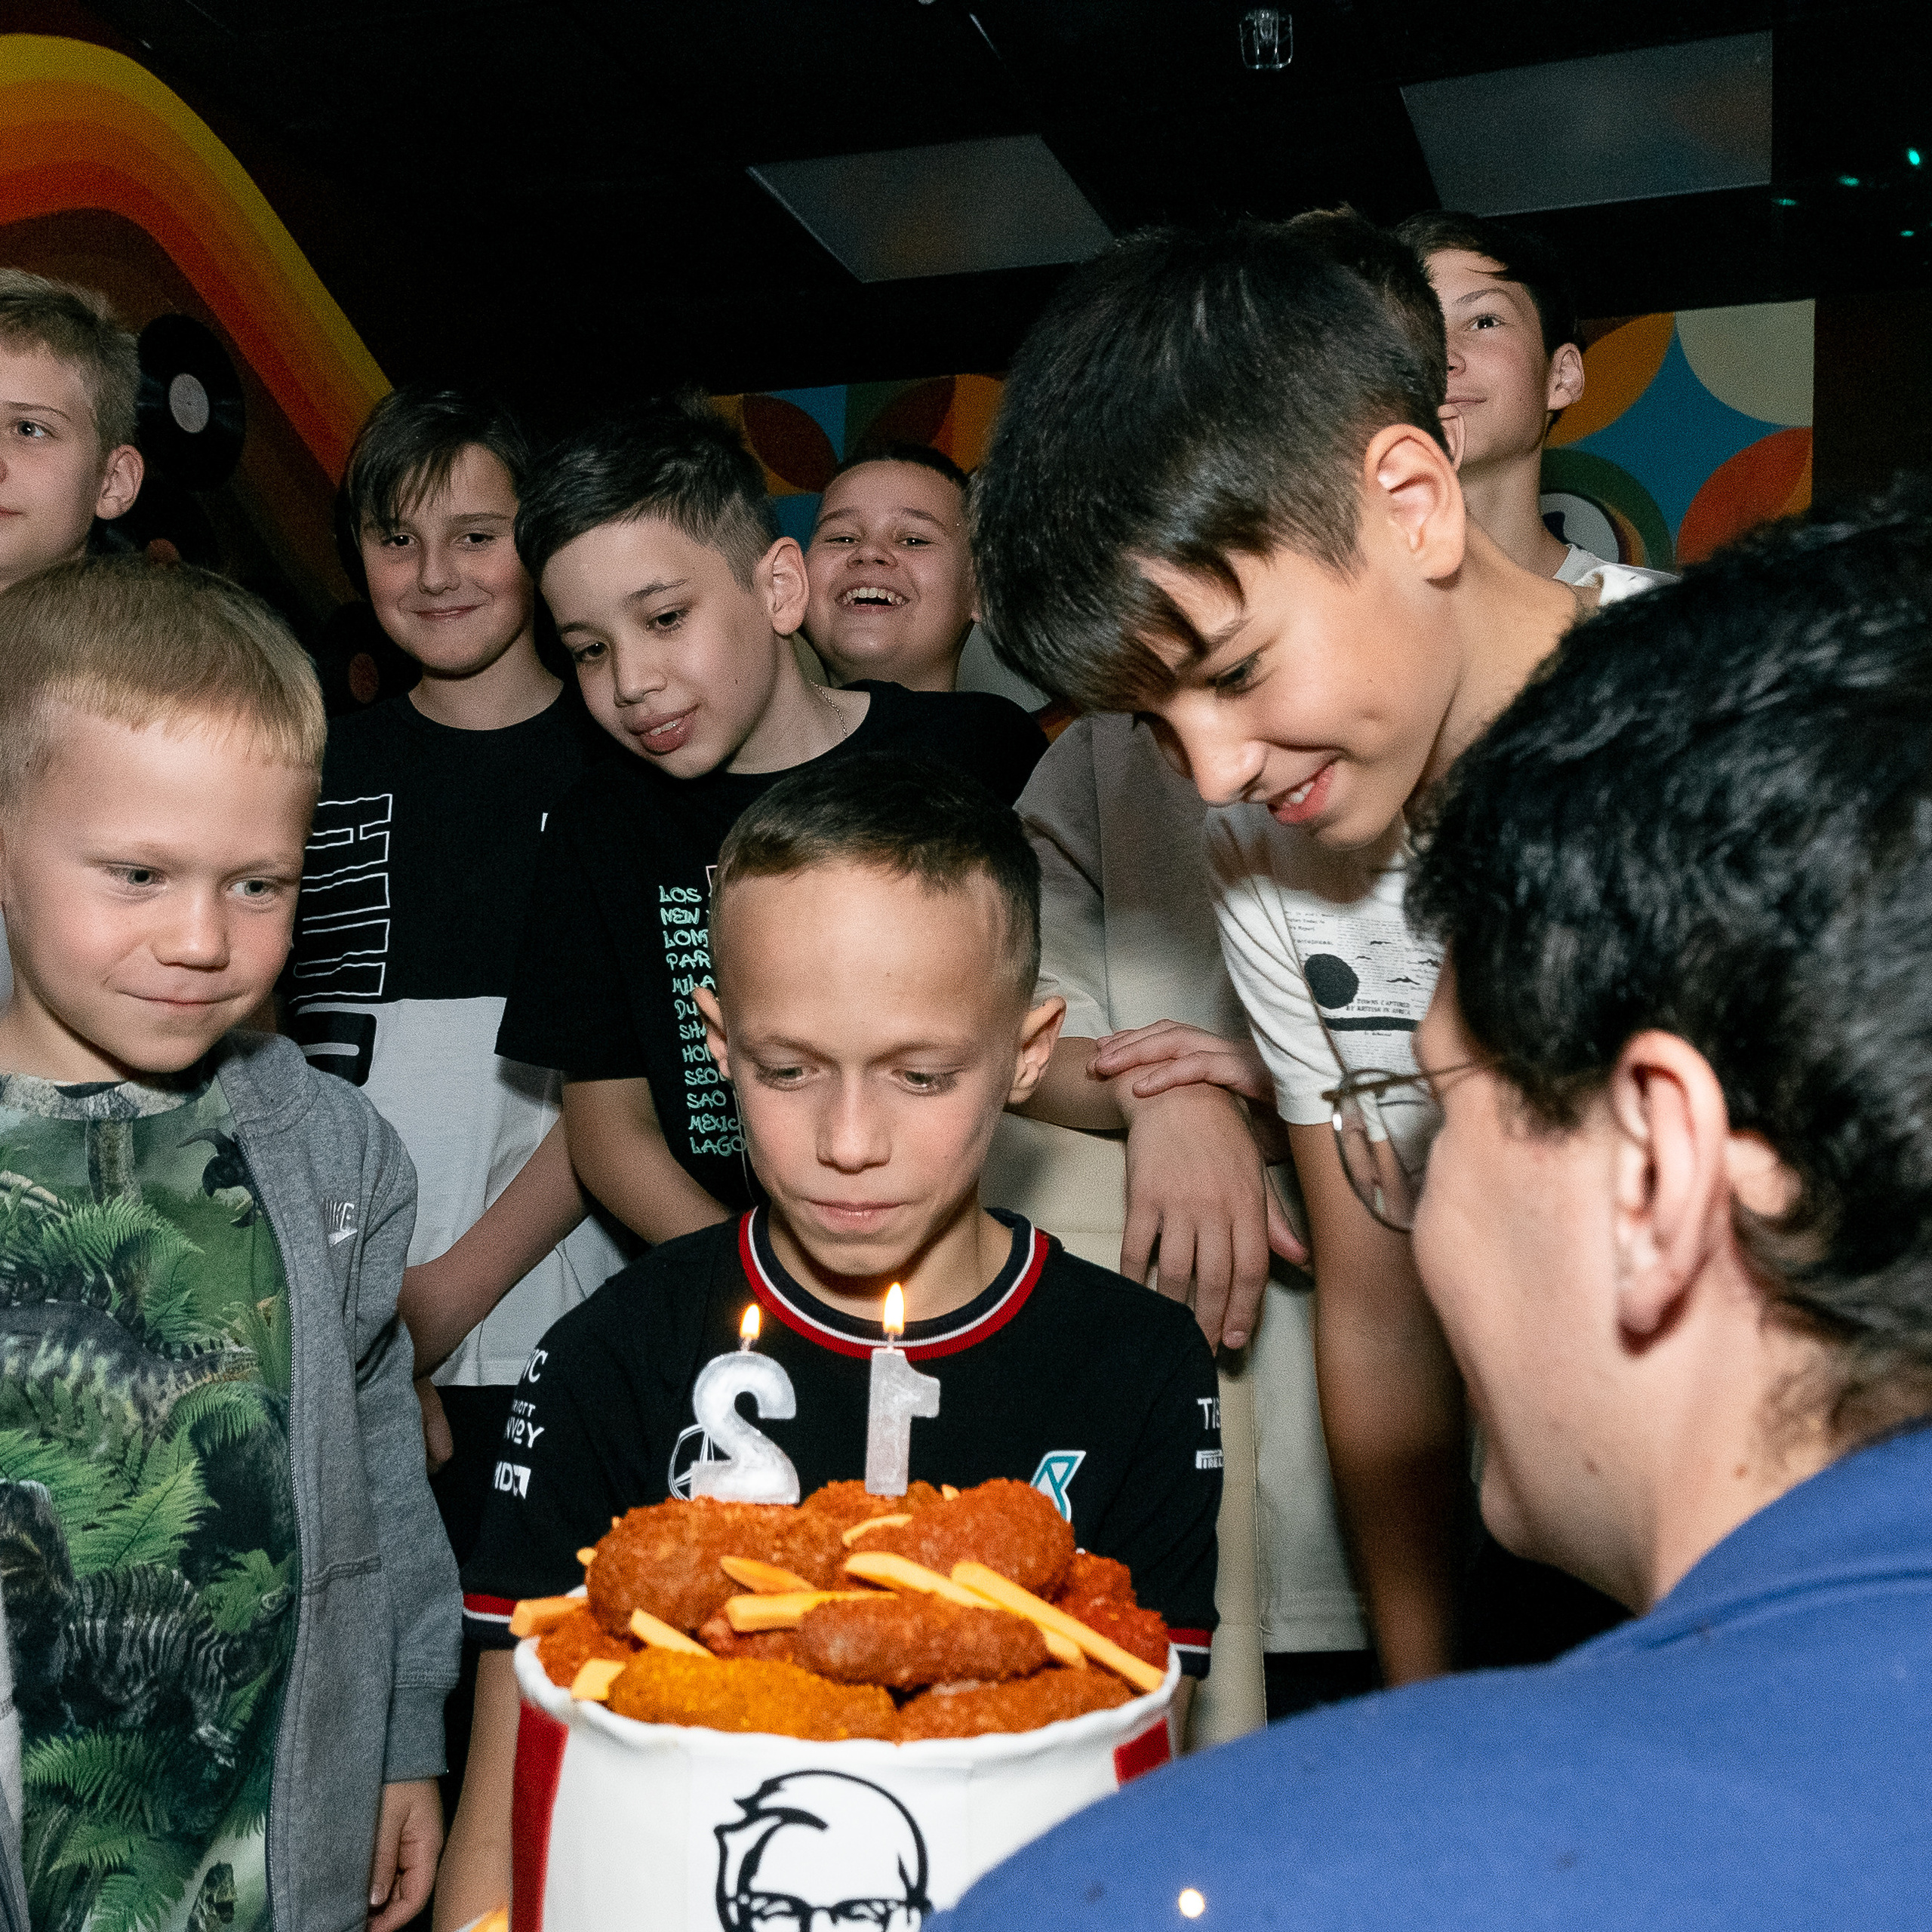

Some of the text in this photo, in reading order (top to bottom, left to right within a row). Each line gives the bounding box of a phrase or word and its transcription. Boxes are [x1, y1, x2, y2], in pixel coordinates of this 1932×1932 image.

[659, 885, 702, 904] LOS
[666, 949, 711, 971] PAR
[672, 974, 716, 995] MILA
[674, 999, 698, 1020] DU
[687, 1090, 727, 1109] SAO
[688, 1113, 740, 1134] MEXIC
[690, 1135, 746, 1156] LAGO
